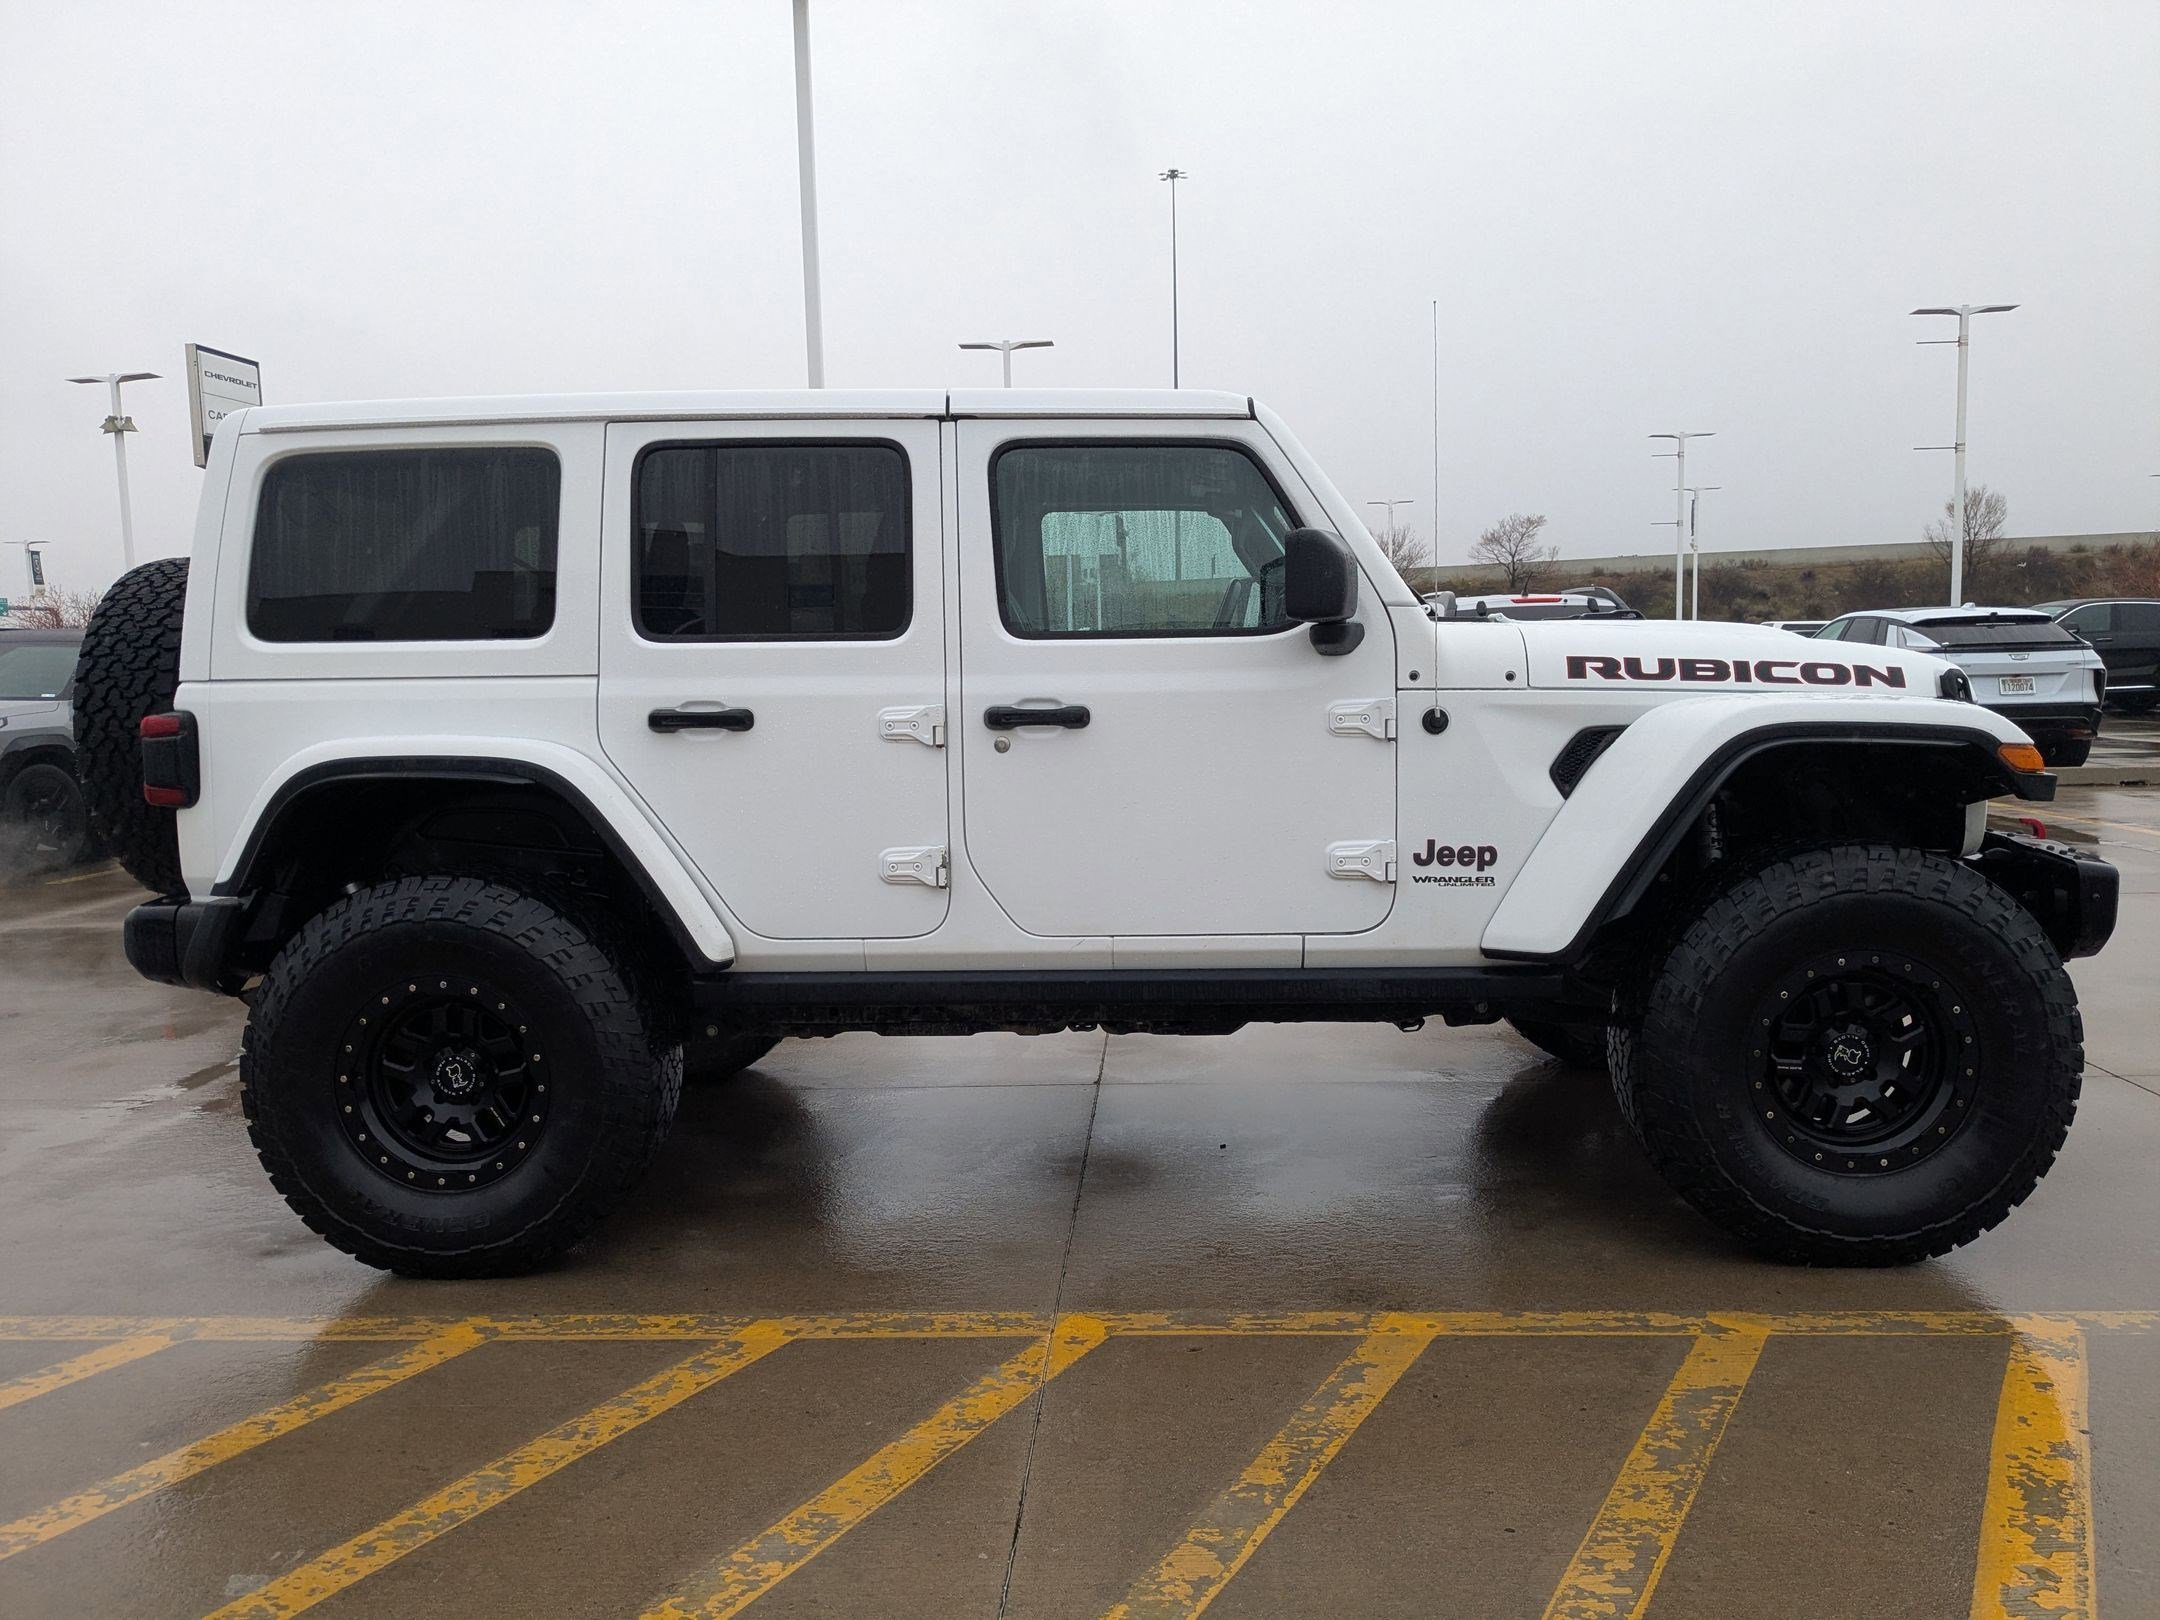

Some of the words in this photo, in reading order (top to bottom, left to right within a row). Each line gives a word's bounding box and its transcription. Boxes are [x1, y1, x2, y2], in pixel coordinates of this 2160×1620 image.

[204, 370, 257, 389] CHEVROLET
[1566, 655, 1906, 688] RUBICON
[1413, 839, 1498, 872] Jeep
